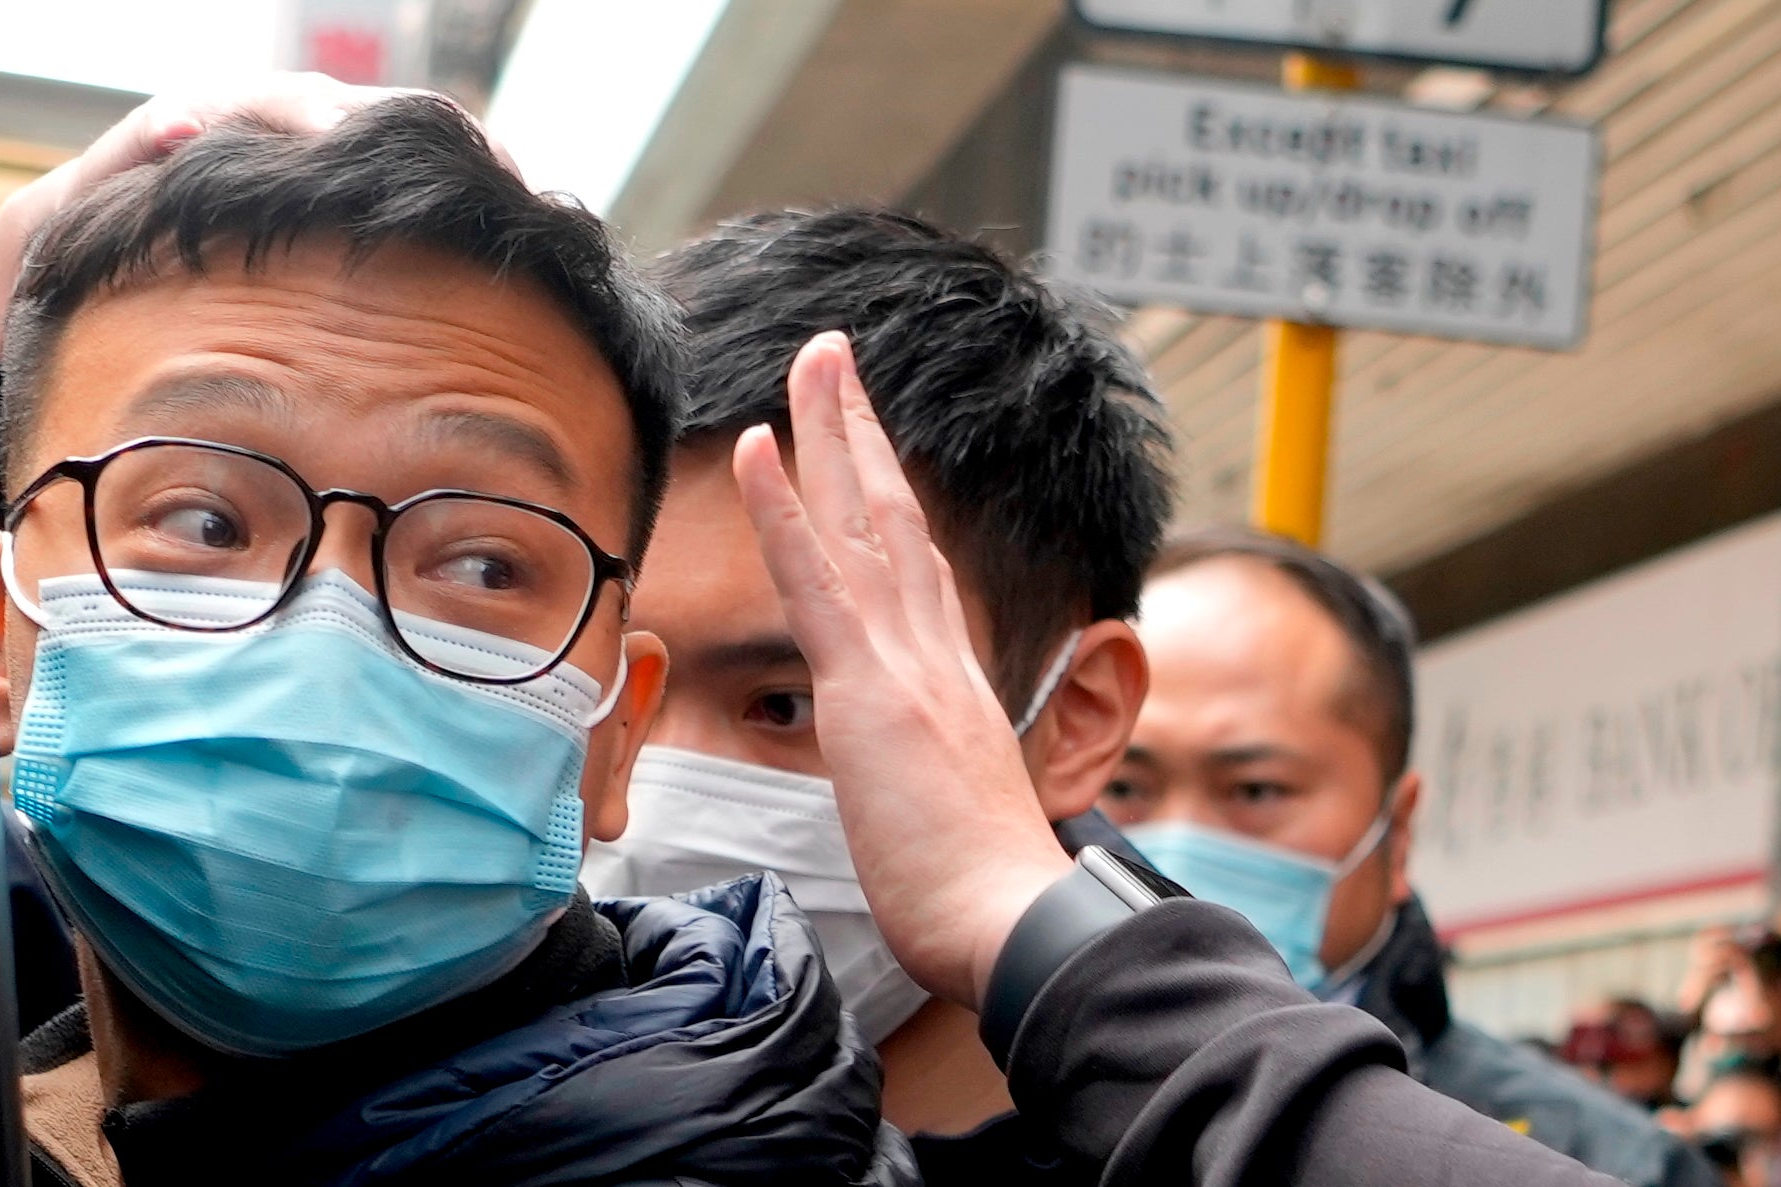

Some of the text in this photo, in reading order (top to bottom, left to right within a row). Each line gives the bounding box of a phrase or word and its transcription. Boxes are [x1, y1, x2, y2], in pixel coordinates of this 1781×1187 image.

[1185, 101, 1479, 177] Except taxi
[1112, 159, 1534, 240] pick up/drop off
